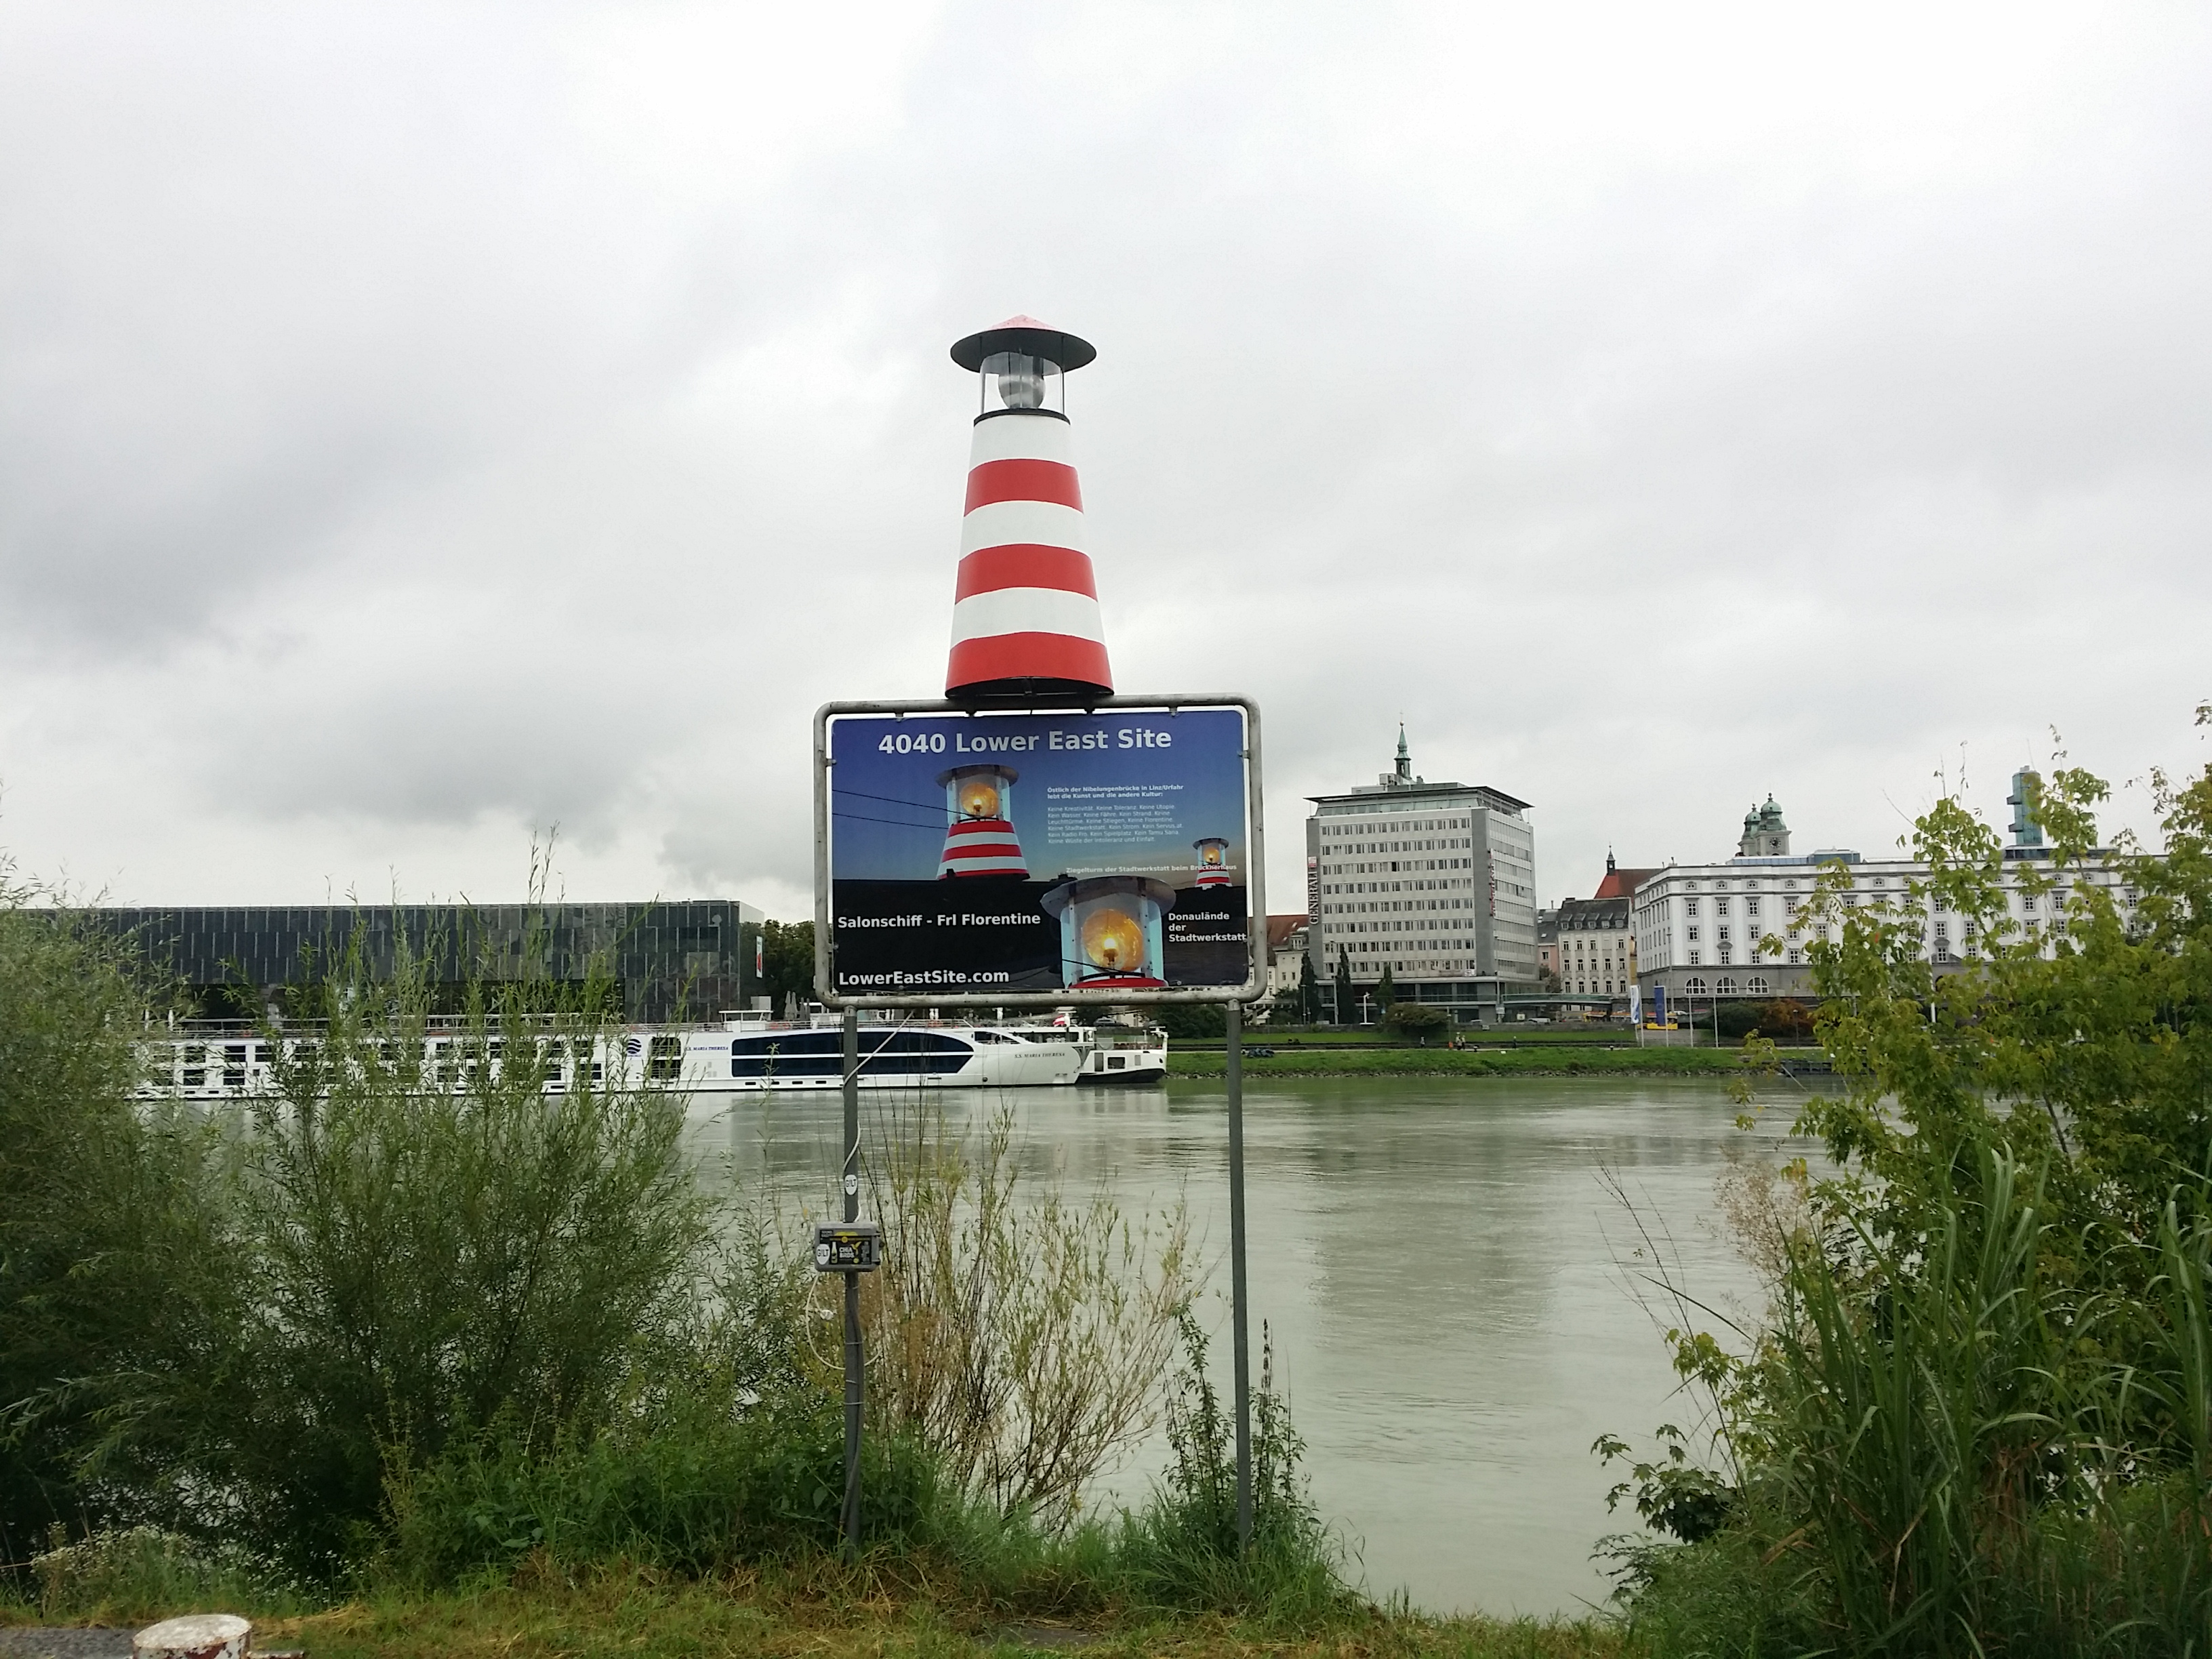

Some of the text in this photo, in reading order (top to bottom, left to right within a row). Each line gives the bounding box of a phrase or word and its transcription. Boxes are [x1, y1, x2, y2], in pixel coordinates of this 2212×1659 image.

[878, 728, 1172, 754] 4040 Lower East Site
[1308, 871, 1319, 925] GENERALI
[838, 914, 923, 928] Salonschiff
[937, 914, 957, 926] Frl
[962, 912, 1041, 926] Florentine
[1168, 912, 1230, 921] Donaulände
[1168, 923, 1187, 932] der
[1168, 933, 1247, 943] Stadtwerkstatt
[839, 969, 1010, 986] LowerEastSite.com
